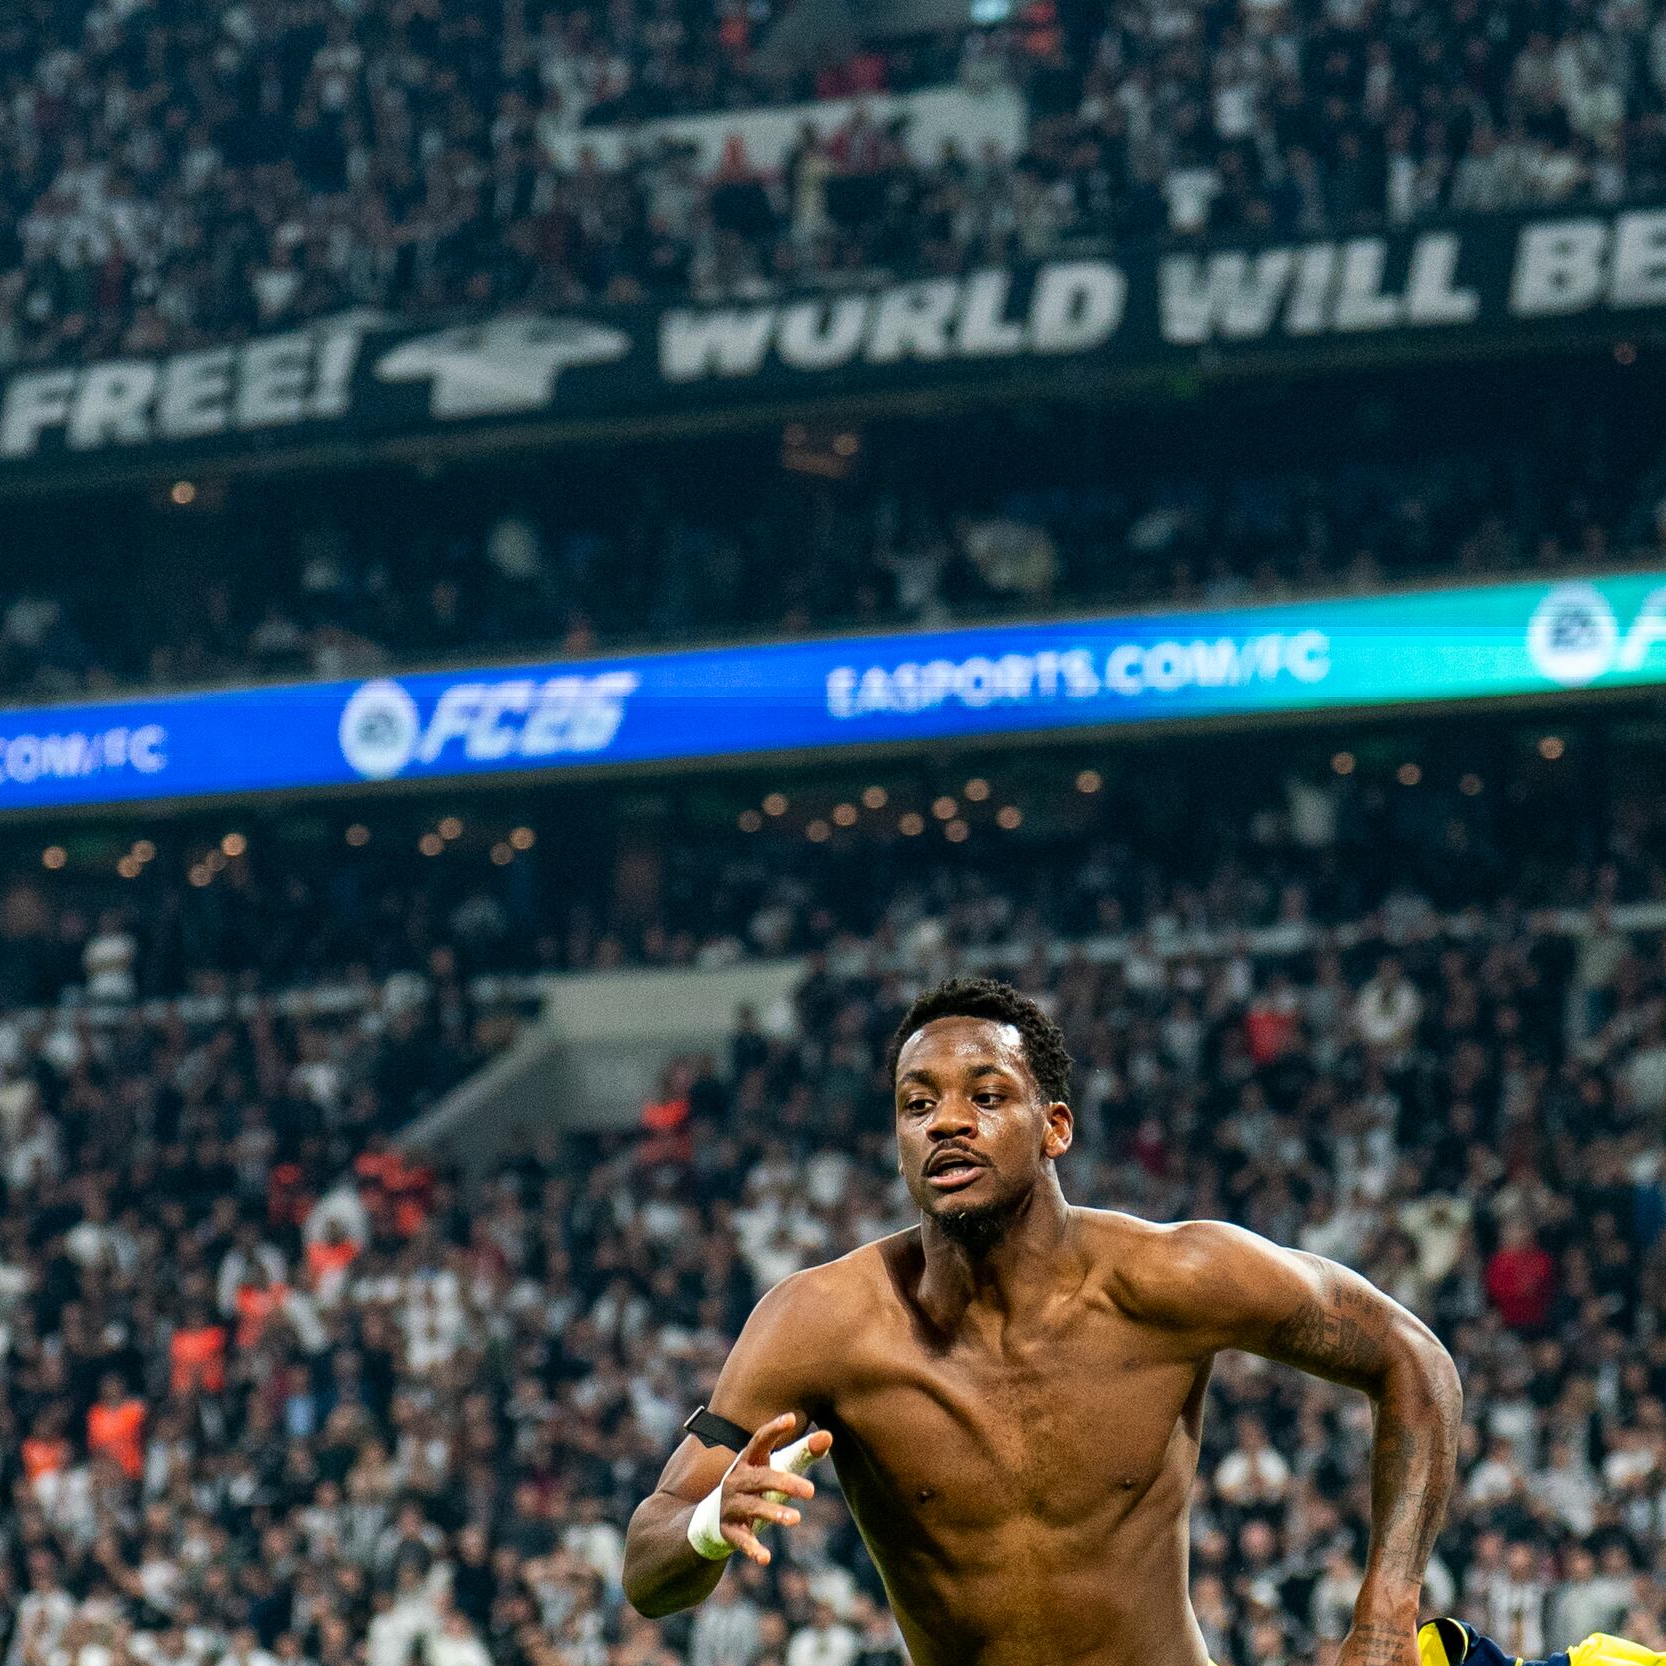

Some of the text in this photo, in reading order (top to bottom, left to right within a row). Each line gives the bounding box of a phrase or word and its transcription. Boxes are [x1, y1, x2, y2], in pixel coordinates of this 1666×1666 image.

[658, 261, 1126, 381] WORLD
[1158, 234, 1478, 346] WILL
[827, 630, 1331, 717] EASPORTS.COM/FC
